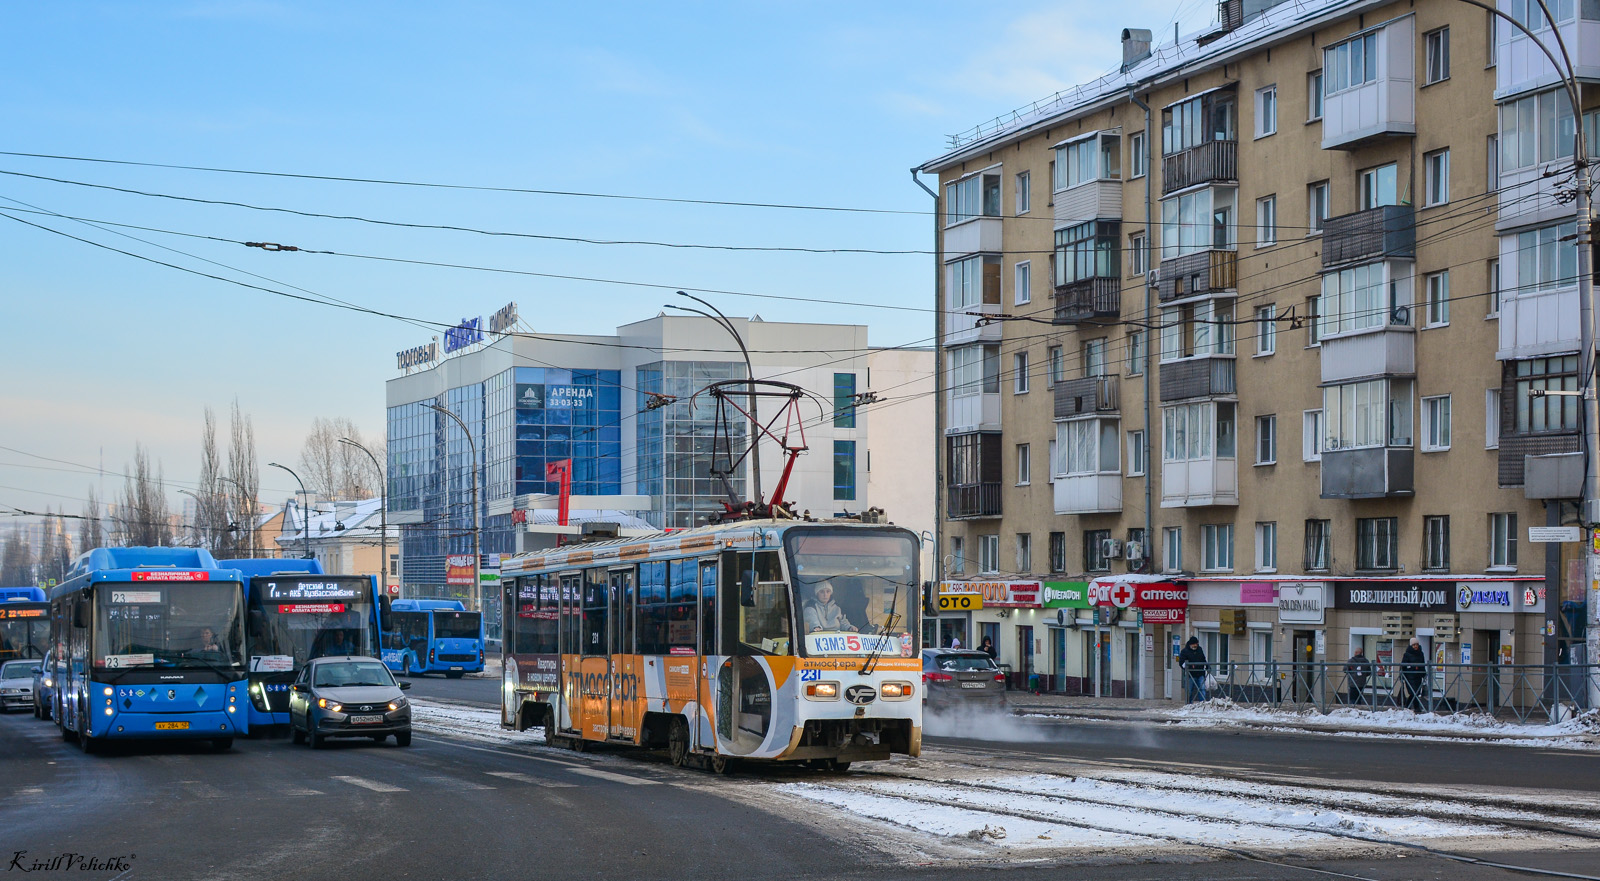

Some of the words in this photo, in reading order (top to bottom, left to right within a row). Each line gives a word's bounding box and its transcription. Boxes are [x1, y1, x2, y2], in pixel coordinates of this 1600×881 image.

[396, 335, 439, 369] ТОРГОВЫЙ
[551, 387, 593, 398] АРЕНДА
[550, 398, 583, 407] 33-03-33
[113, 593, 126, 602] 23
[1141, 589, 1189, 600] аптека
[1350, 586, 1418, 604] ЮВЕЛИРНЫЙ
[1420, 590, 1447, 607] ДОМ
[1459, 587, 1510, 607] ЛОМБАРД
[939, 597, 971, 608] ОТО
[1280, 599, 1301, 611] GOLDEN
[1302, 599, 1320, 612] HALL
[815, 637, 846, 652] КЭМЗ
[846, 636, 861, 651] 5
[106, 657, 119, 668] 23
[252, 657, 262, 672] 7
[803, 658, 856, 670] атмосфера
[801, 669, 821, 682] 231
